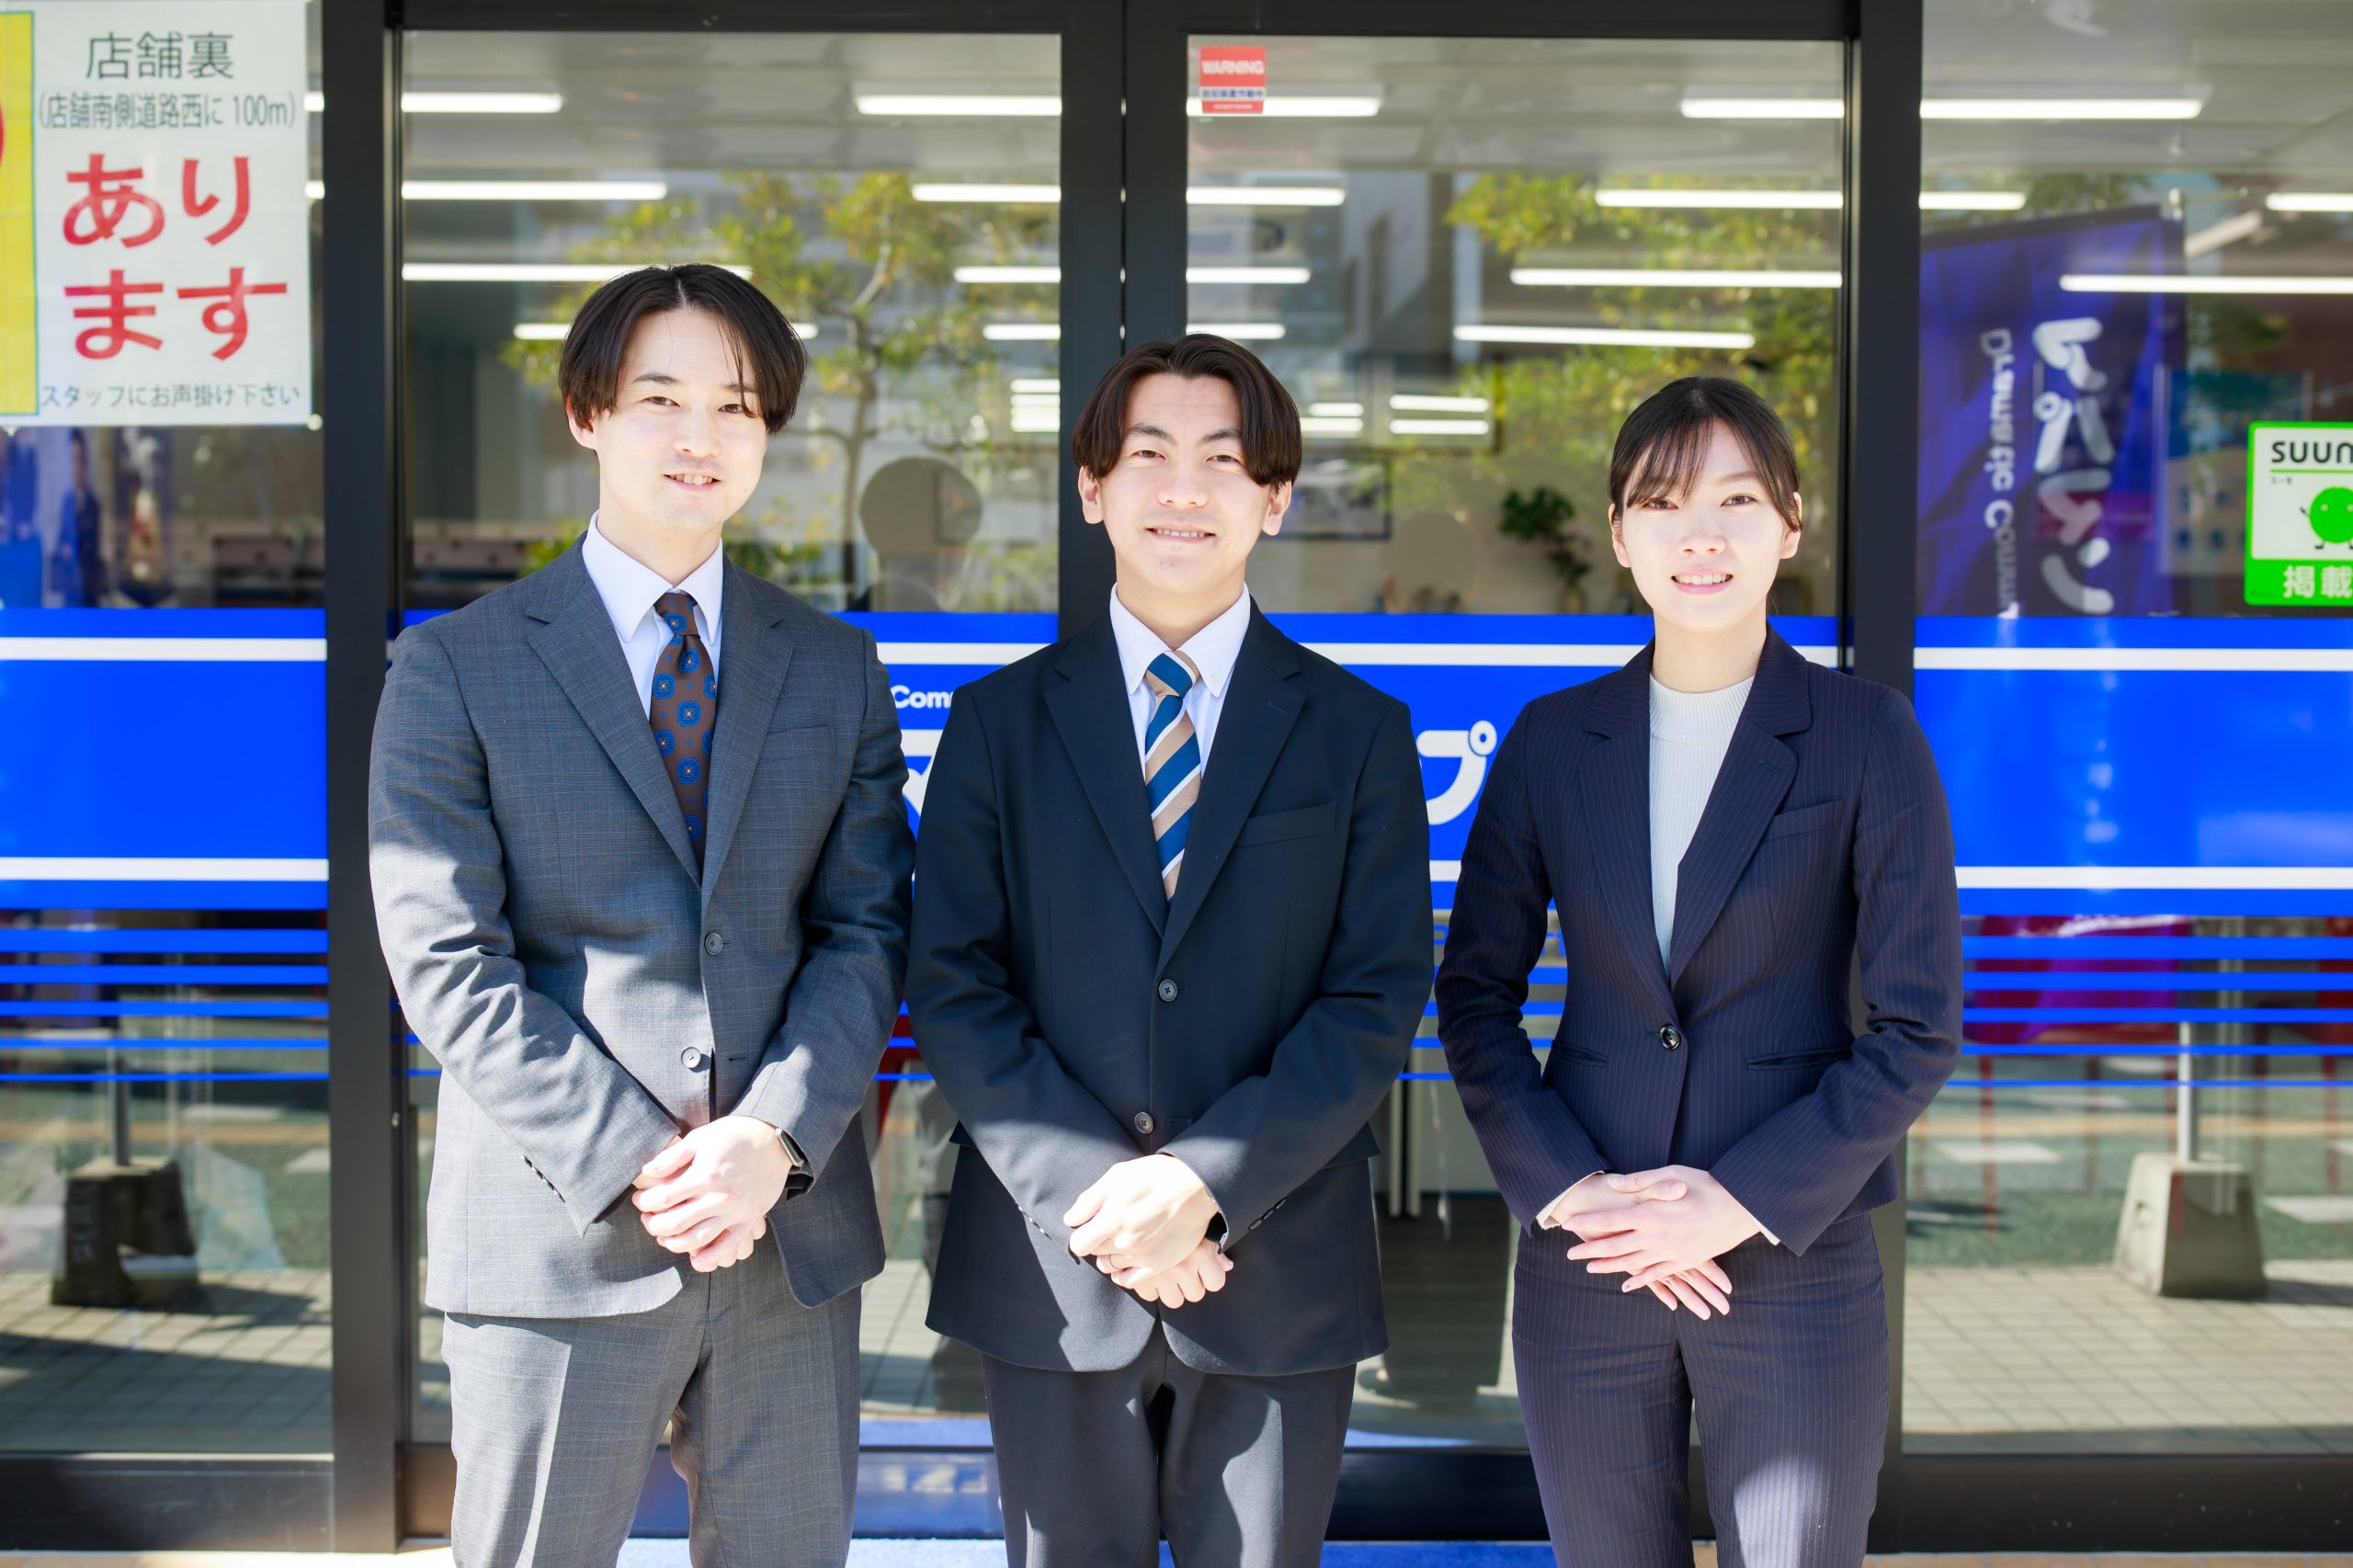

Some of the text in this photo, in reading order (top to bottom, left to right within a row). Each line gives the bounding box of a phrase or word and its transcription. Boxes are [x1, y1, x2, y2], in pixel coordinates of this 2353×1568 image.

[85, 31, 234, 80] 店舗裏
[1201, 60, 1265, 75] WARNING
[63, 153, 250, 248] あり
[63, 267, 288, 361] ます
[40, 382, 301, 408] スタッフにお声掛け下さい
[2282, 564, 2353, 599] 掲載
[890, 685, 954, 709] Com
